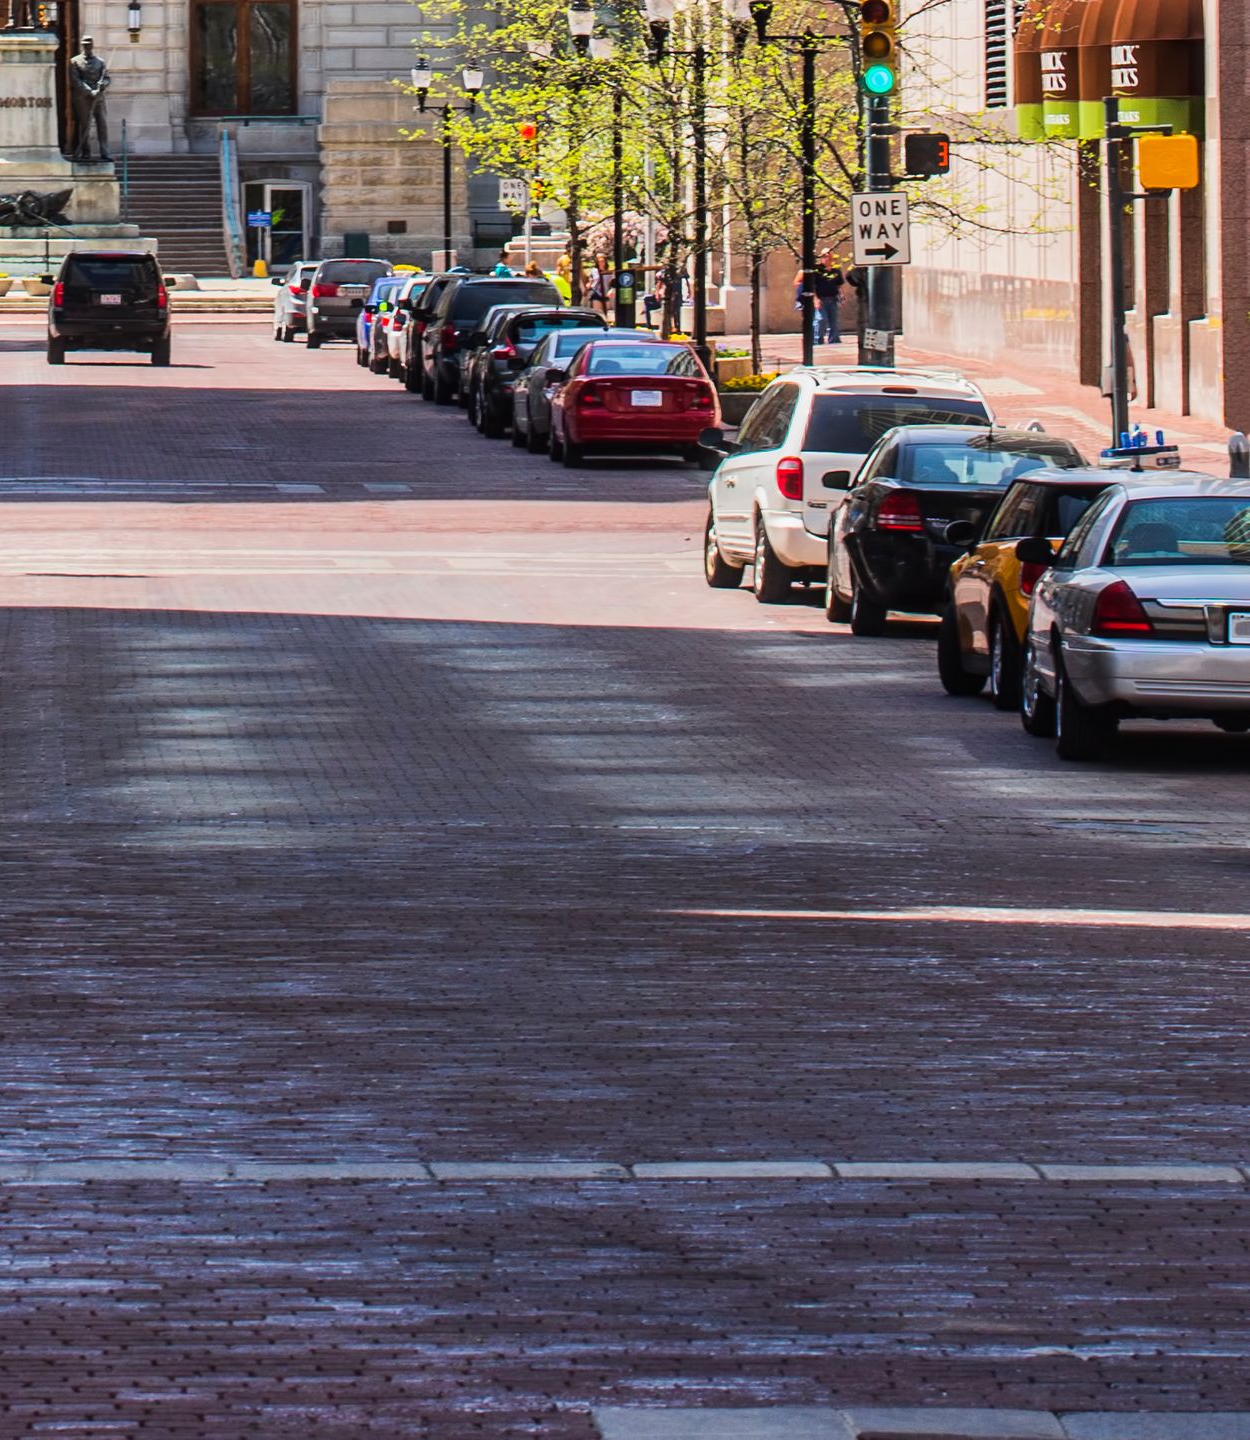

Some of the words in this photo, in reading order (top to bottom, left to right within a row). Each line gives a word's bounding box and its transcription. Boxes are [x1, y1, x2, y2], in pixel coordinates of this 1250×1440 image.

[937, 141, 949, 167] 3
[502, 181, 523, 190] ONE
[859, 200, 902, 217] ONE
[859, 222, 904, 239] WAY
